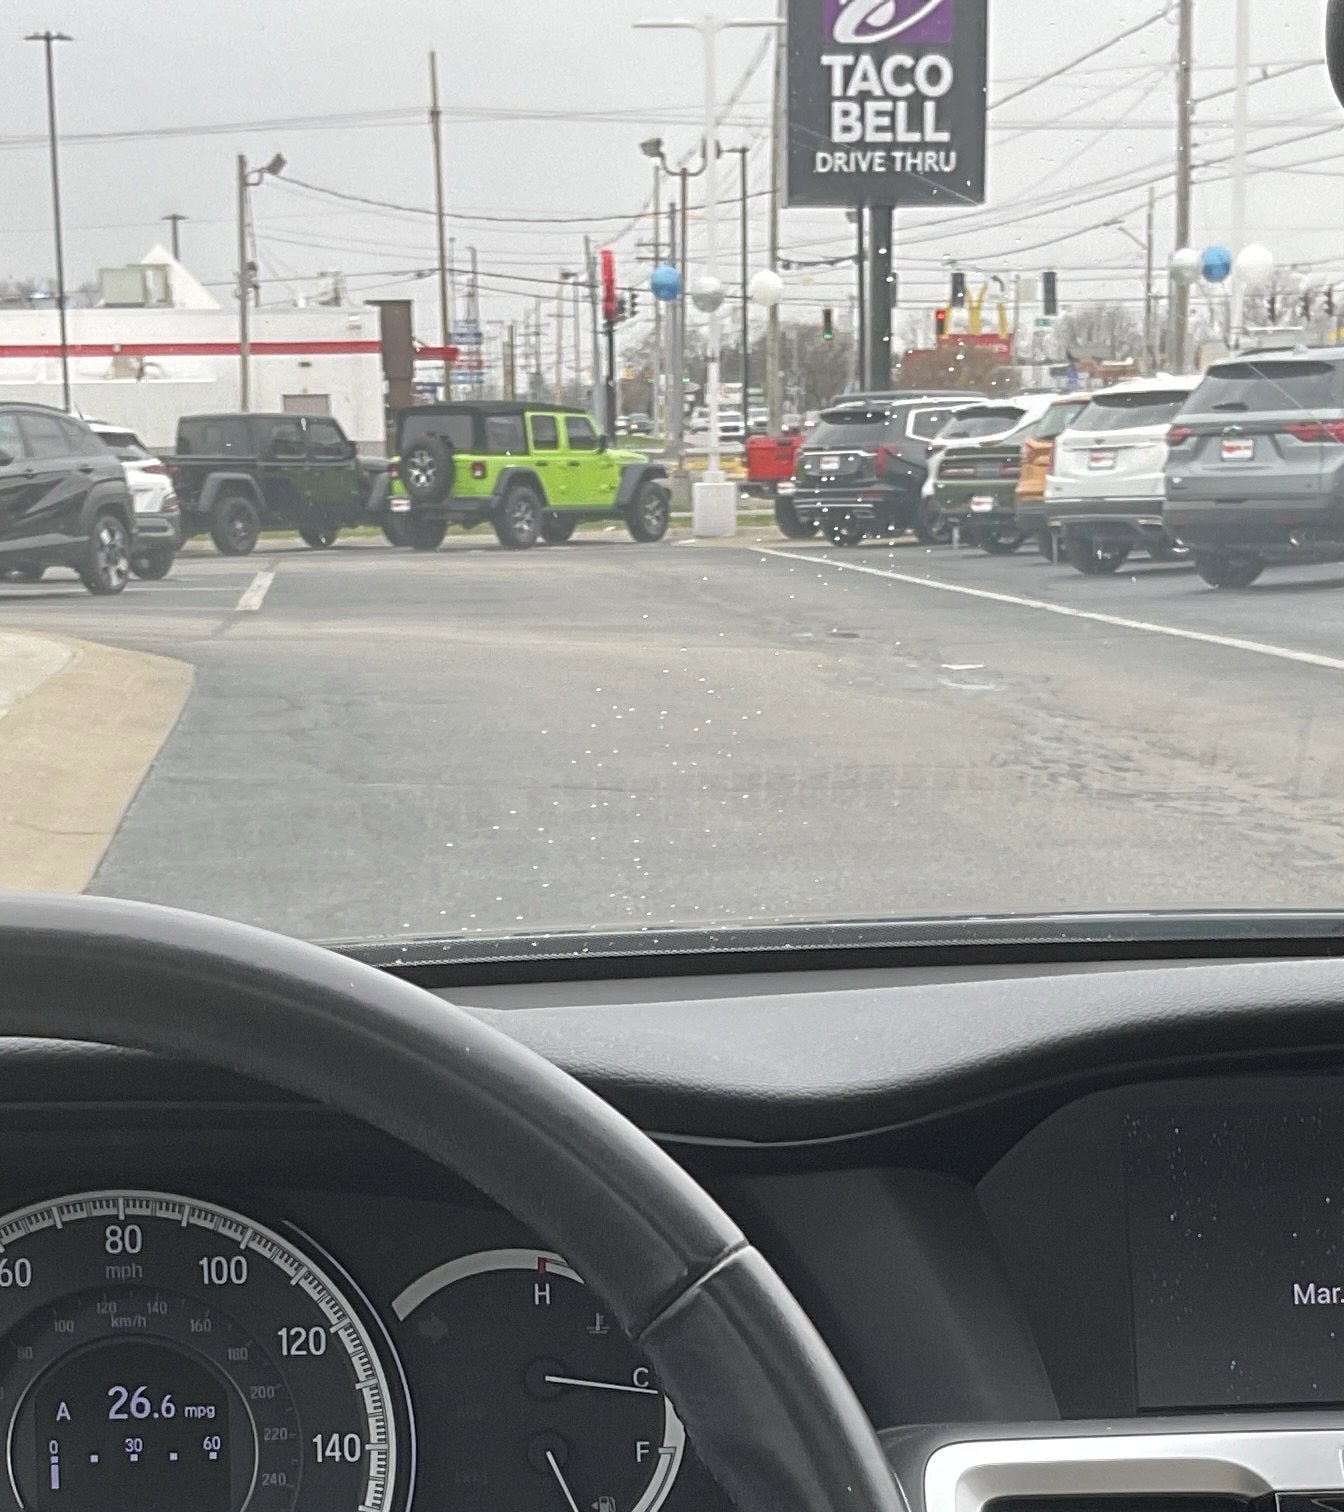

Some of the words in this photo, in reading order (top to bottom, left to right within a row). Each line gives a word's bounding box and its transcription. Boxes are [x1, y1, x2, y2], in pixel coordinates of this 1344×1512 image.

[819, 54, 954, 98] TACO
[830, 103, 951, 143] BELL
[813, 151, 885, 174] DRIVE
[890, 150, 956, 173] THRU
[105, 1224, 143, 1254] 80
[106, 1263, 143, 1279] mph
[198, 1255, 248, 1285] 100
[533, 1283, 552, 1306] H
[1292, 1283, 1344, 1305] Mar.
[110, 1309, 147, 1328] km/h
[146, 1301, 168, 1315] 140
[190, 1318, 211, 1333] 160
[277, 1326, 327, 1356] 120
[631, 1367, 650, 1388] C
[56, 1401, 72, 1421] A
[107, 1385, 176, 1421] 26.6
[184, 1404, 216, 1420] mpg
[250, 1386, 275, 1400] 200
[124, 1438, 144, 1453] 30
[203, 1436, 222, 1452] 60
[263, 1427, 289, 1442] 220
[312, 1433, 361, 1463] 140
[635, 1441, 651, 1463] F
[262, 1473, 287, 1487] 240
